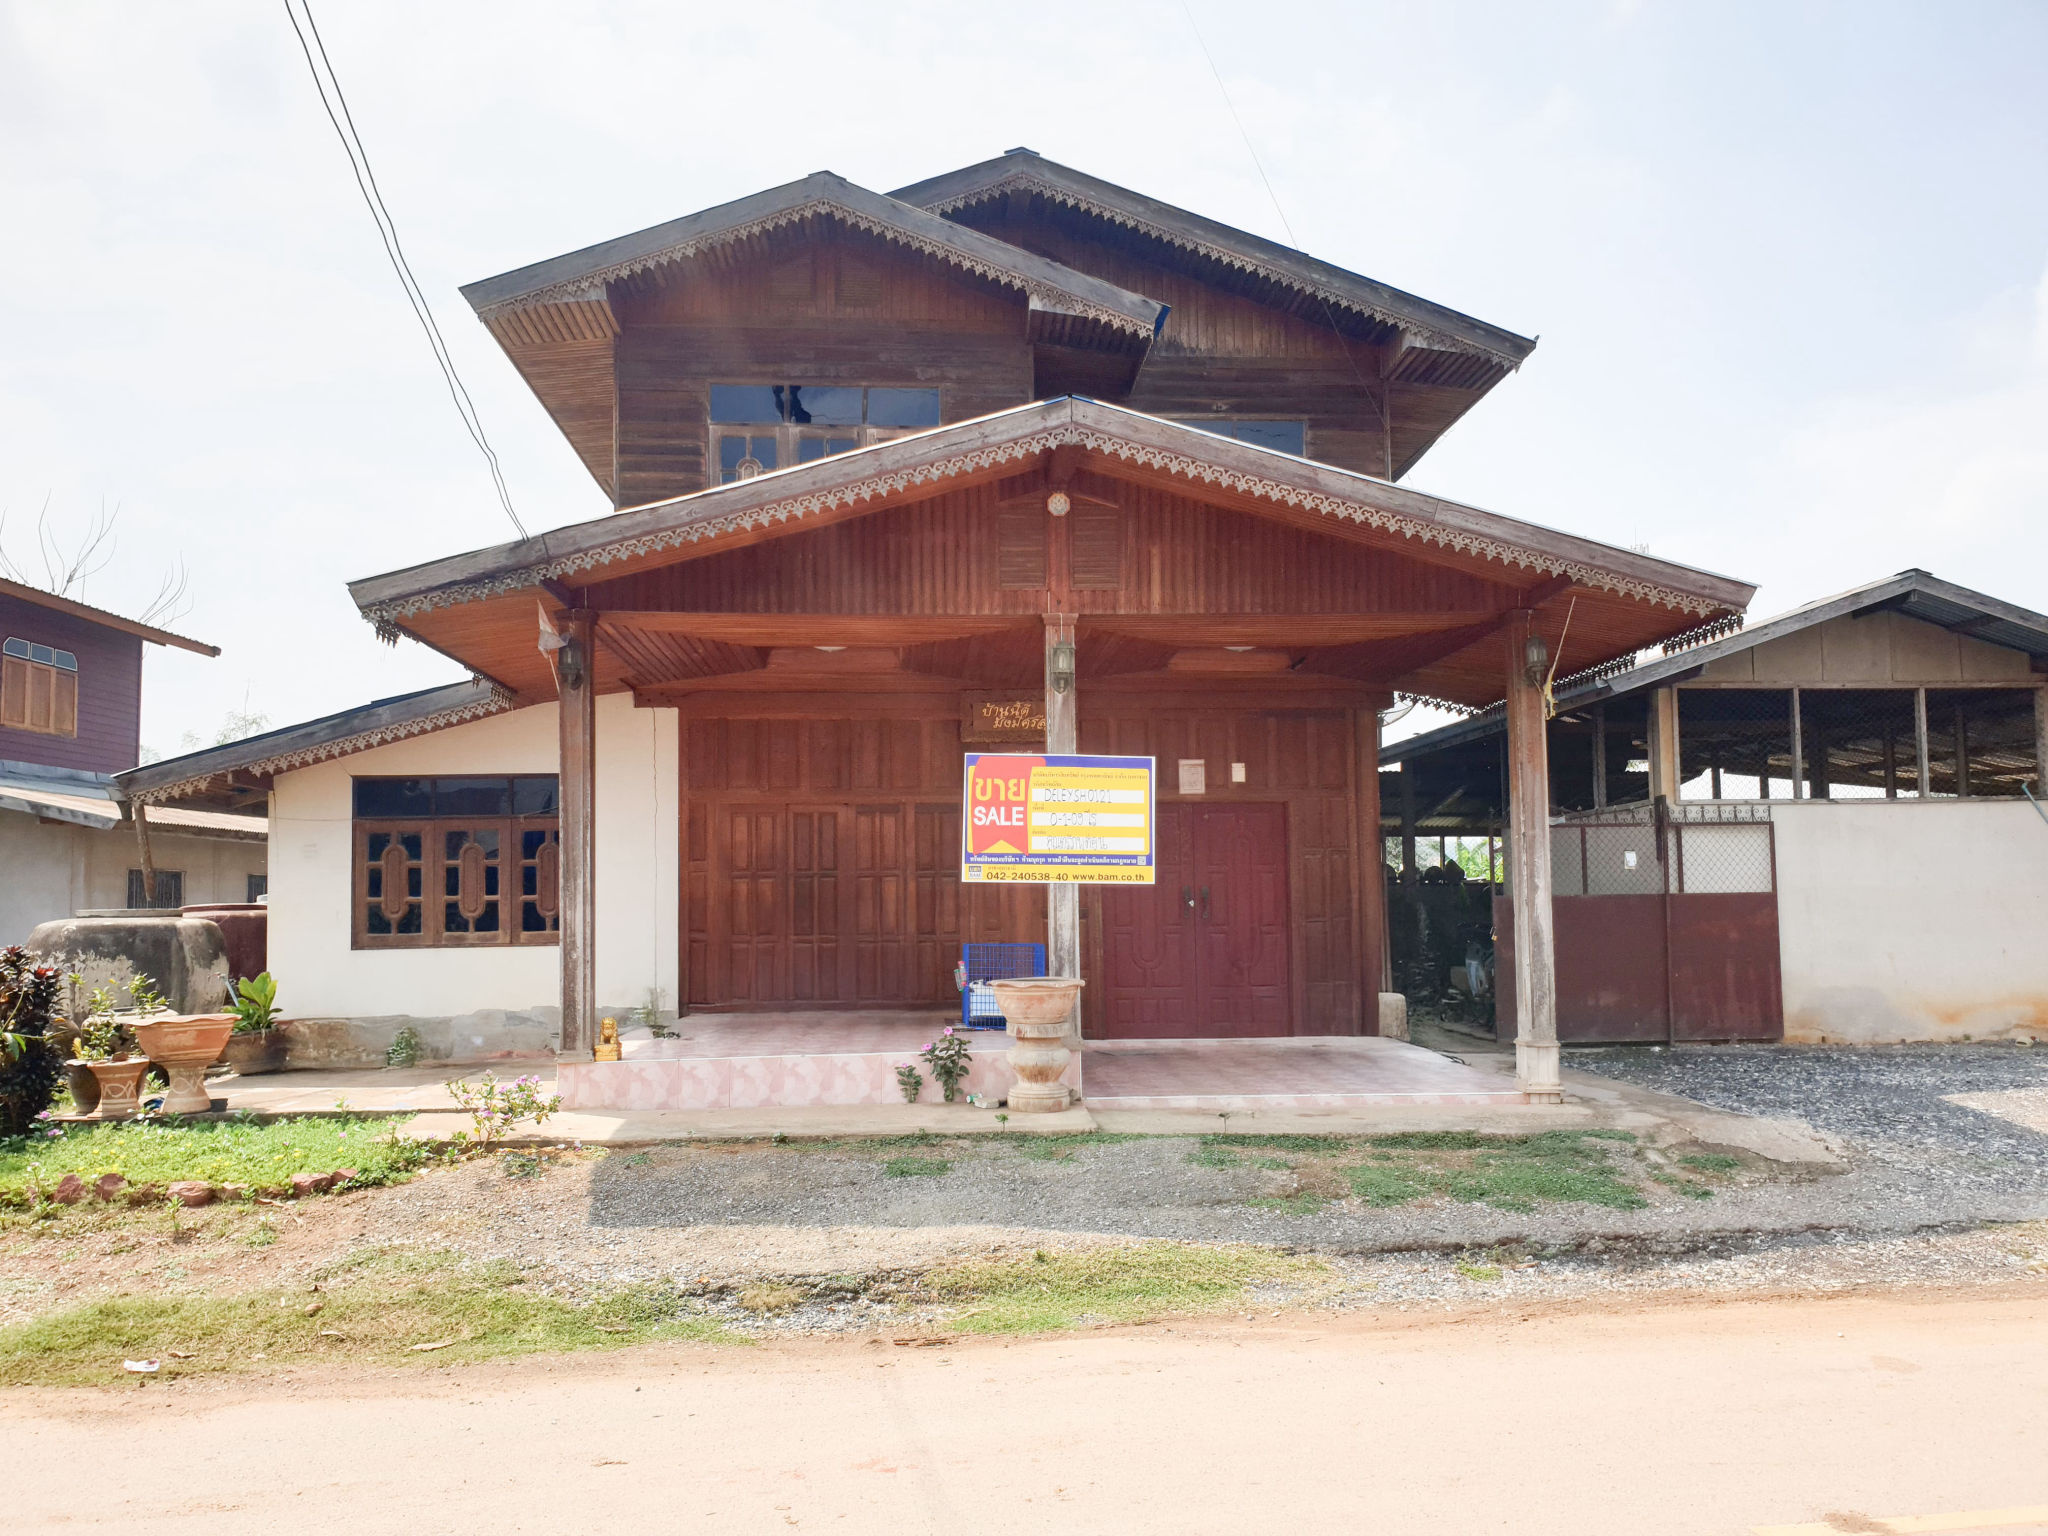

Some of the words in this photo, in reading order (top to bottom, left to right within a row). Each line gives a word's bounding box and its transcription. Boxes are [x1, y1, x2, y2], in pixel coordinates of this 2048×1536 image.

[993, 714, 1048, 730] มั่งมีศรีสุ
[975, 777, 1026, 802] ขาย
[973, 806, 1025, 827] SALE
[986, 872, 1069, 881] 042-240538-40
[1072, 873, 1145, 881] www.bam.co.th
